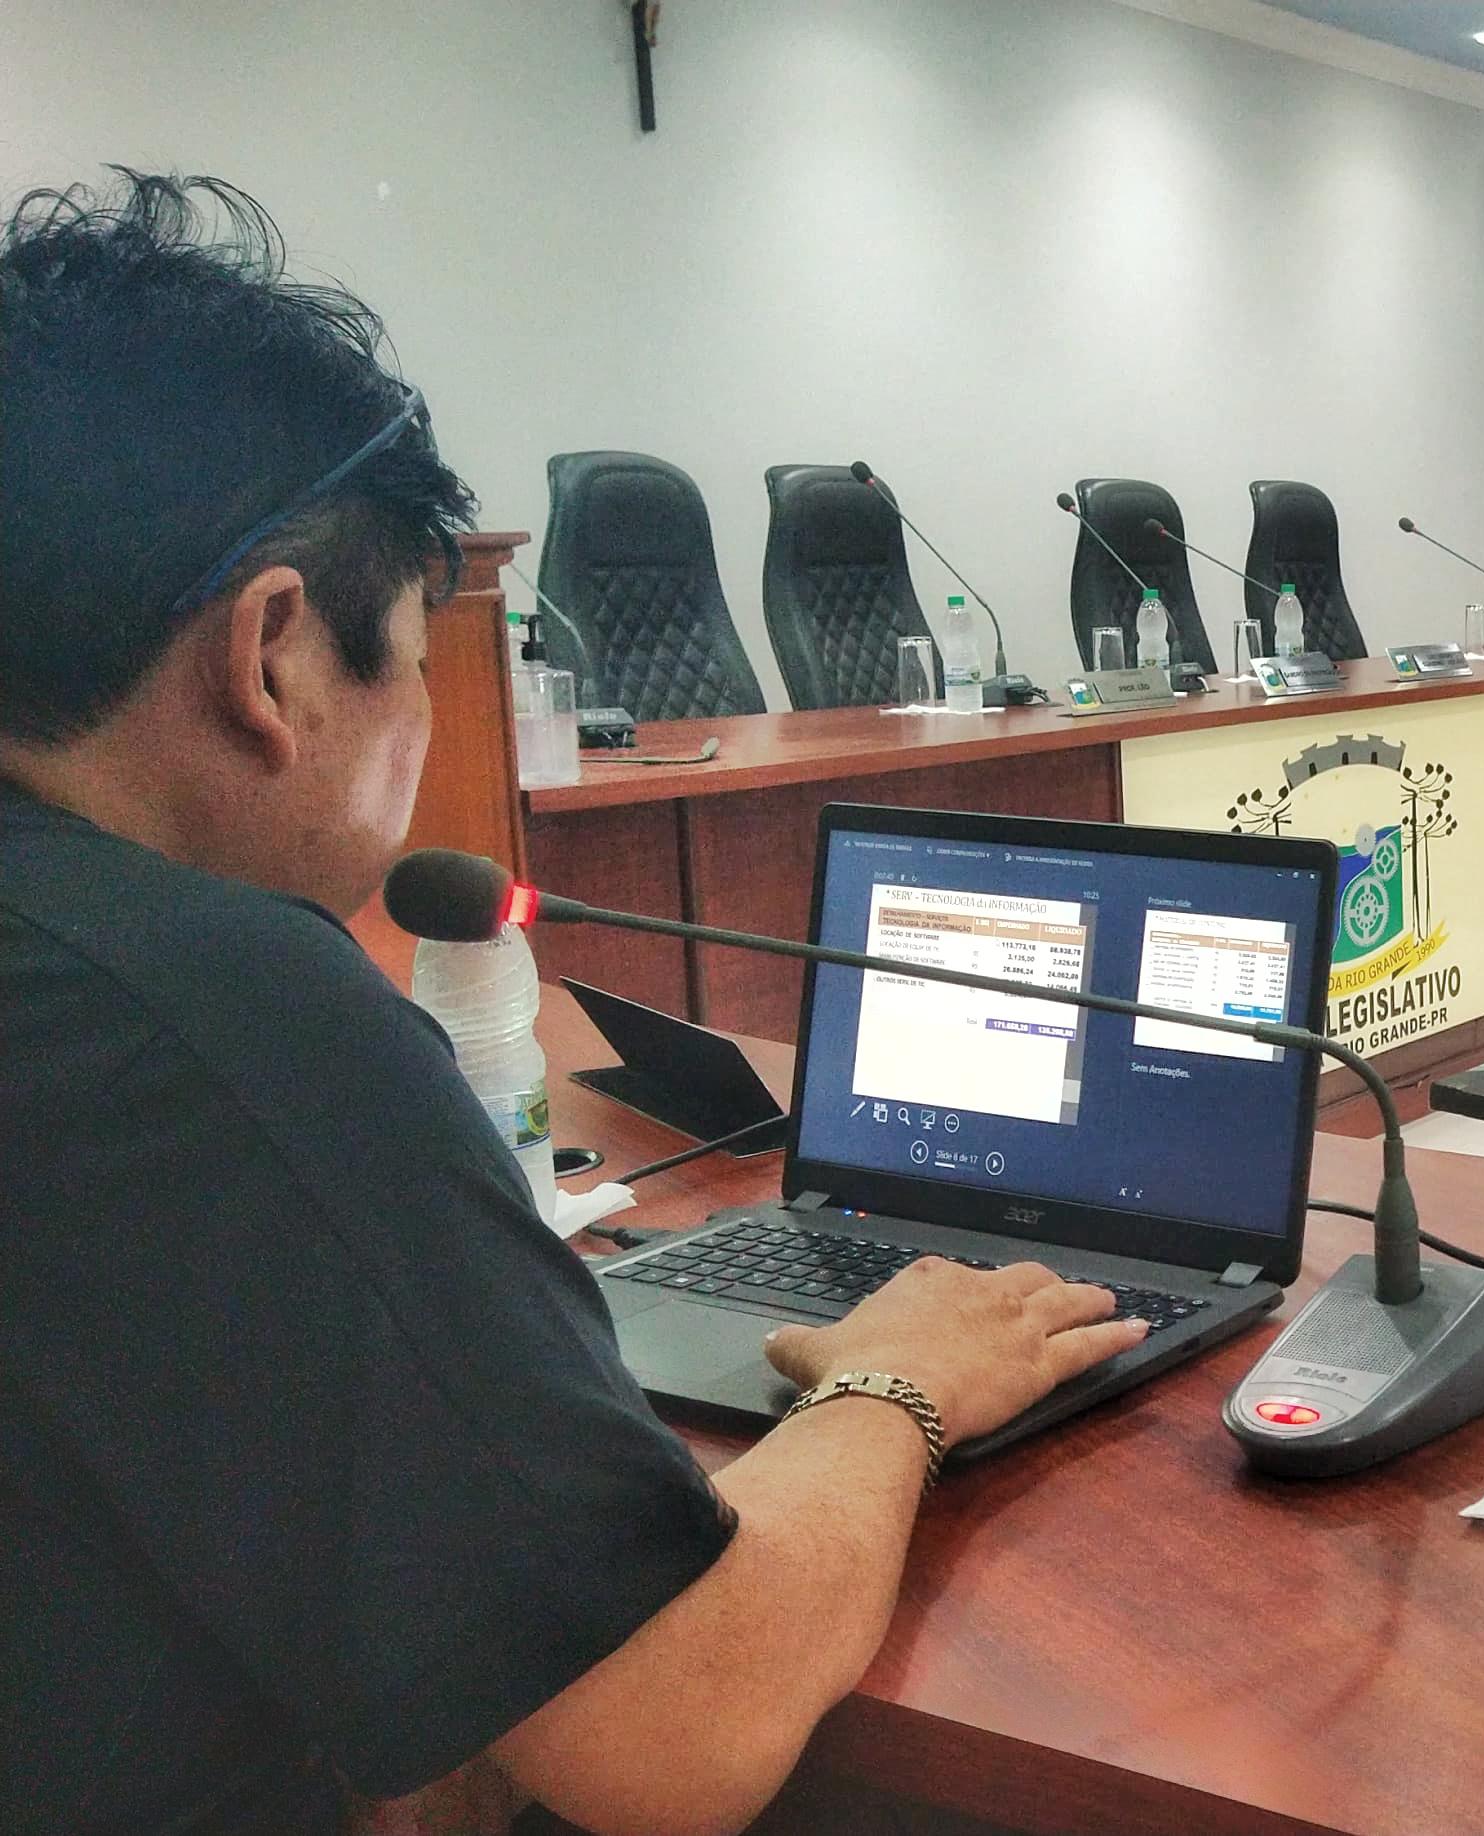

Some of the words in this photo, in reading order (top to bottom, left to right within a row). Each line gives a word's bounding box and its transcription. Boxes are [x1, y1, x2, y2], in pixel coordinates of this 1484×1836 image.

[921, 892, 975, 907] TECNOLOGIA
[988, 898, 1047, 914] INFORMAÇÃO
[1416, 938, 1436, 961] 1990
[1345, 969, 1366, 988] RIO
[1368, 940, 1411, 983] GRANDE
[1327, 965, 1461, 1038] LEGISLATIVO
[1369, 1007, 1448, 1049] GRANDE-PR
[1129, 1062, 1148, 1073] Sem
[970, 1154, 978, 1165] 17
[1003, 1206, 1046, 1225] acer
